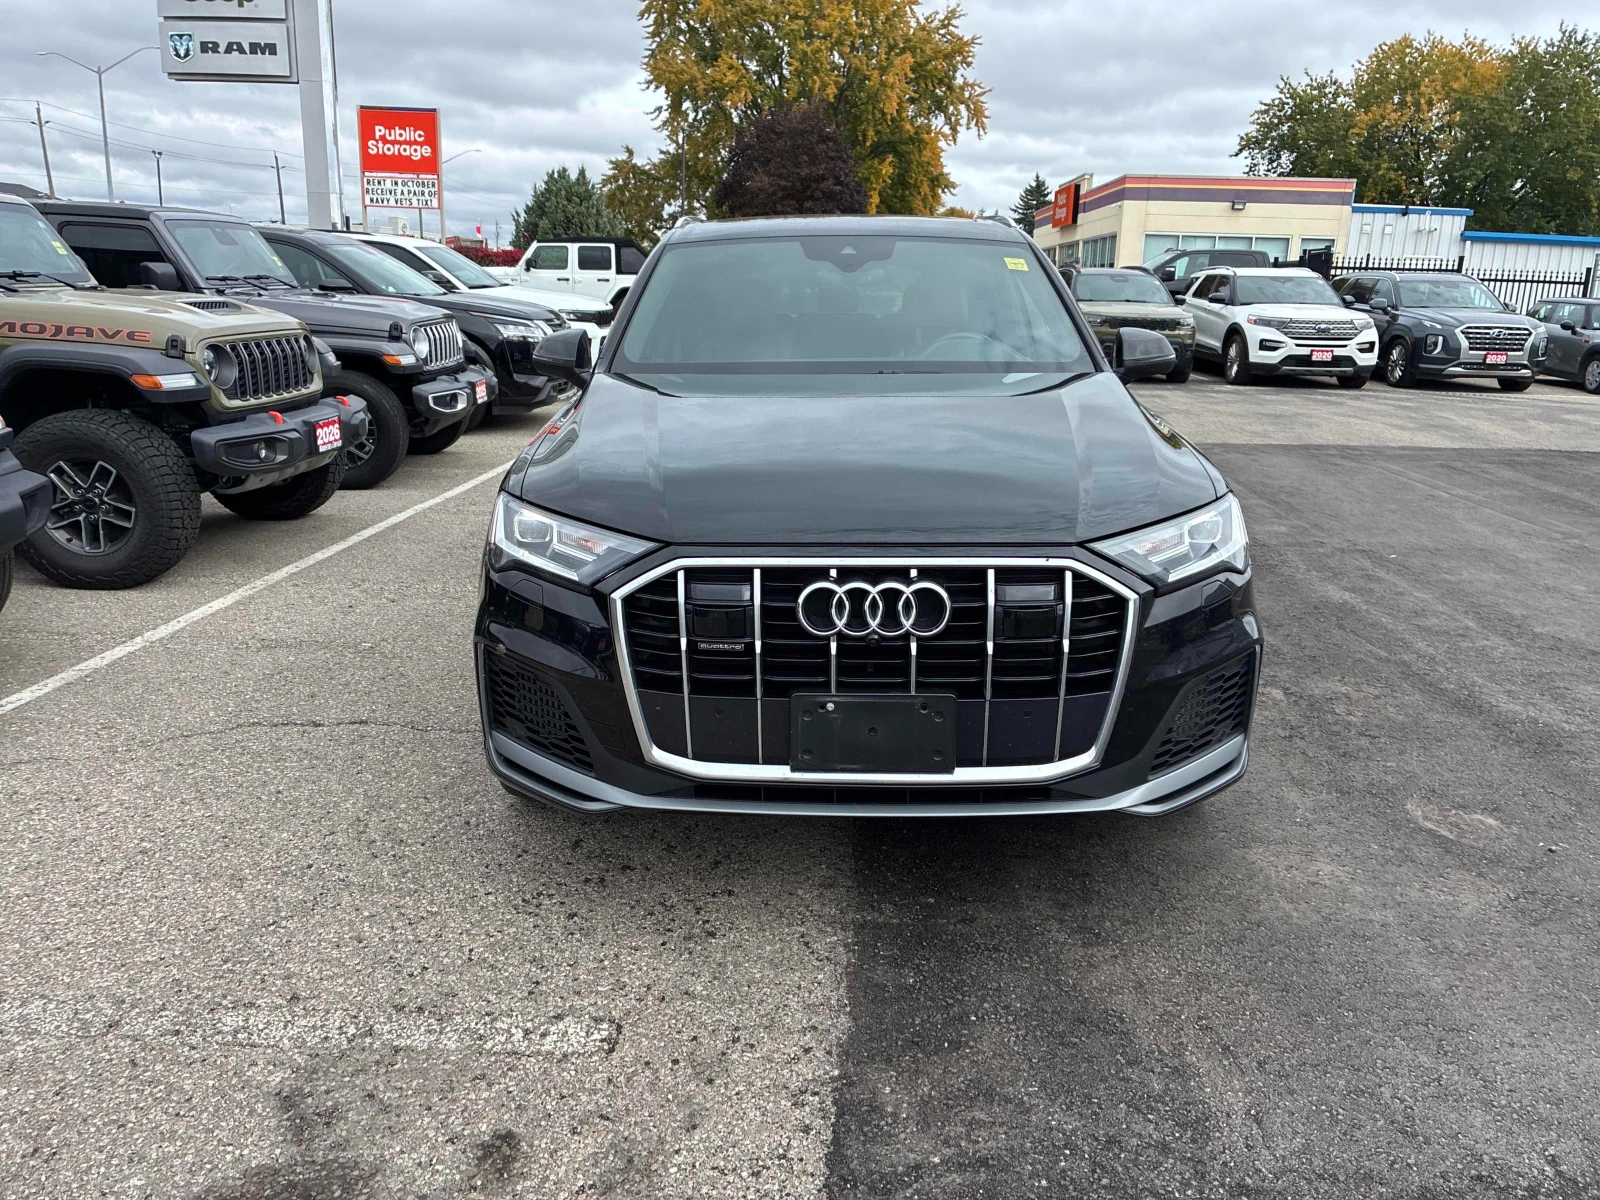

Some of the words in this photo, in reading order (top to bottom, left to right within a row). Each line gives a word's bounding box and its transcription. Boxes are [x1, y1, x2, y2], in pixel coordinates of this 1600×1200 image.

[199, 40, 278, 56] RAM
[374, 125, 425, 142] Public
[367, 140, 432, 160] Storage
[366, 178, 387, 187] RENT
[391, 179, 399, 187] IN
[401, 180, 436, 189] OCTOBER
[365, 187, 398, 197] RECEIVE
[400, 189, 405, 197] A
[407, 189, 426, 198] PAIR
[428, 190, 438, 199] OF
[369, 196, 391, 205] NAVY
[394, 197, 413, 206] VETS
[416, 198, 433, 207] TIX!
[1312, 351, 1332, 359] 2020
[1486, 354, 1507, 362] 2020
[316, 423, 341, 445] 2026
